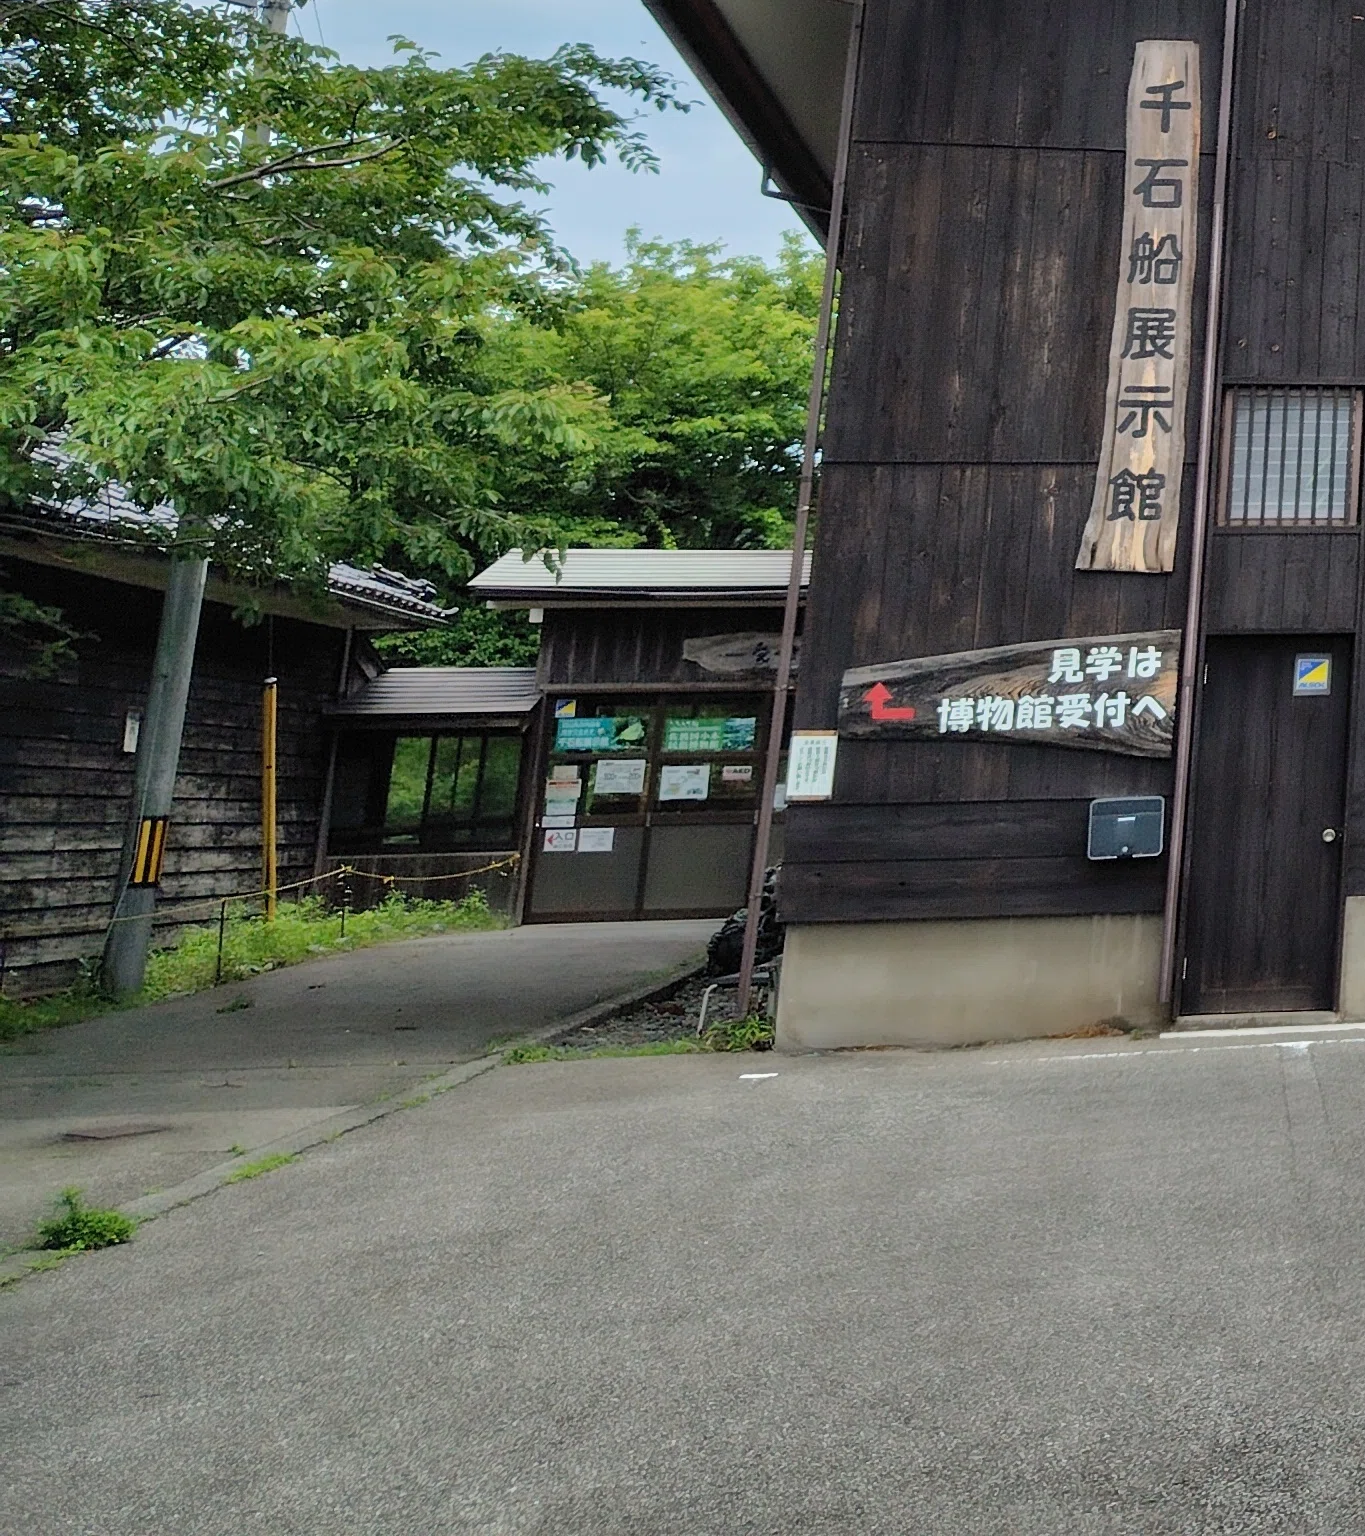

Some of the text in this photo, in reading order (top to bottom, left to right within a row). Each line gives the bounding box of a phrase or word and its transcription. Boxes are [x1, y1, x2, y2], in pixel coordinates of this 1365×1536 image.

[1106, 79, 1193, 522] 千石船展示館
[1047, 645, 1163, 684] 見学は
[936, 690, 1168, 734] 博物館受付へ
